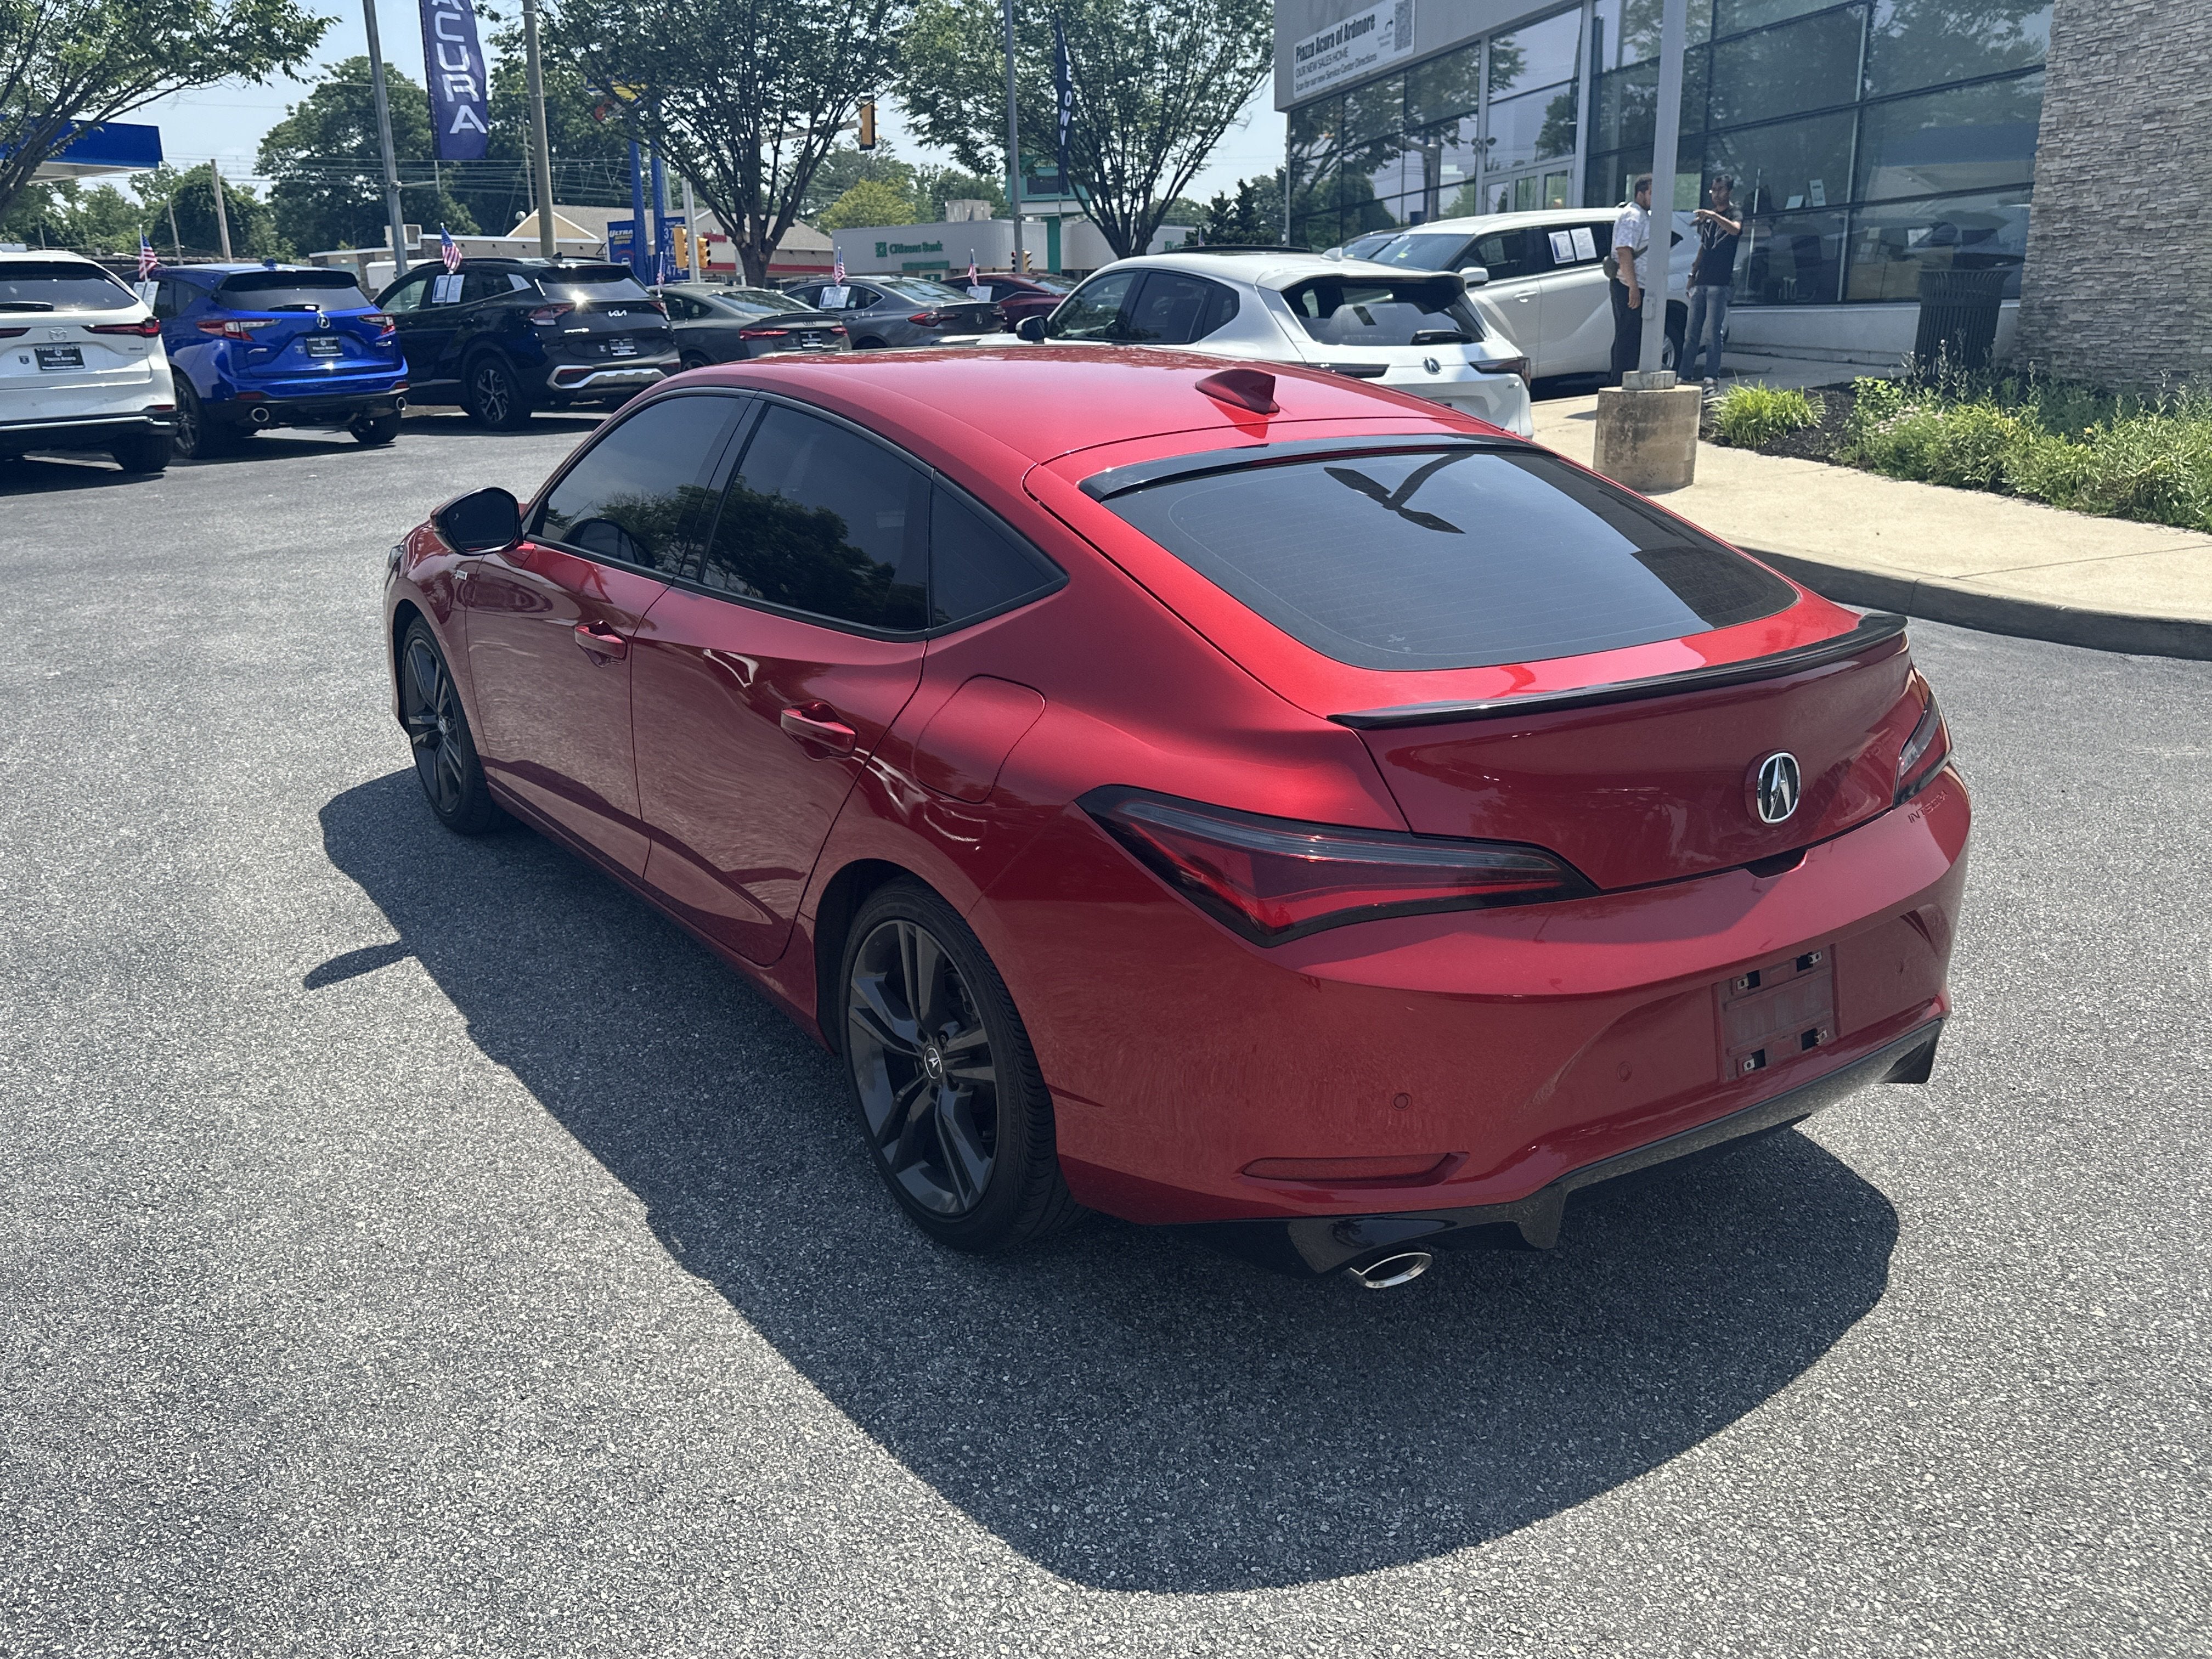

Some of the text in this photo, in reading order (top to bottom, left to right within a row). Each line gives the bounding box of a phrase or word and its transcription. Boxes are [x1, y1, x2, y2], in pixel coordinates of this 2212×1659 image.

[1296, 42, 1314, 64] Piazza
[1316, 33, 1334, 55] Acura
[1336, 25, 1343, 45] of
[1344, 14, 1375, 42] Ardmore
[1318, 54, 1332, 69] SALES
[1332, 46, 1348, 61] HOME
[609, 229, 633, 238] ULTRA
[889, 240, 943, 255] Citizens Bank
